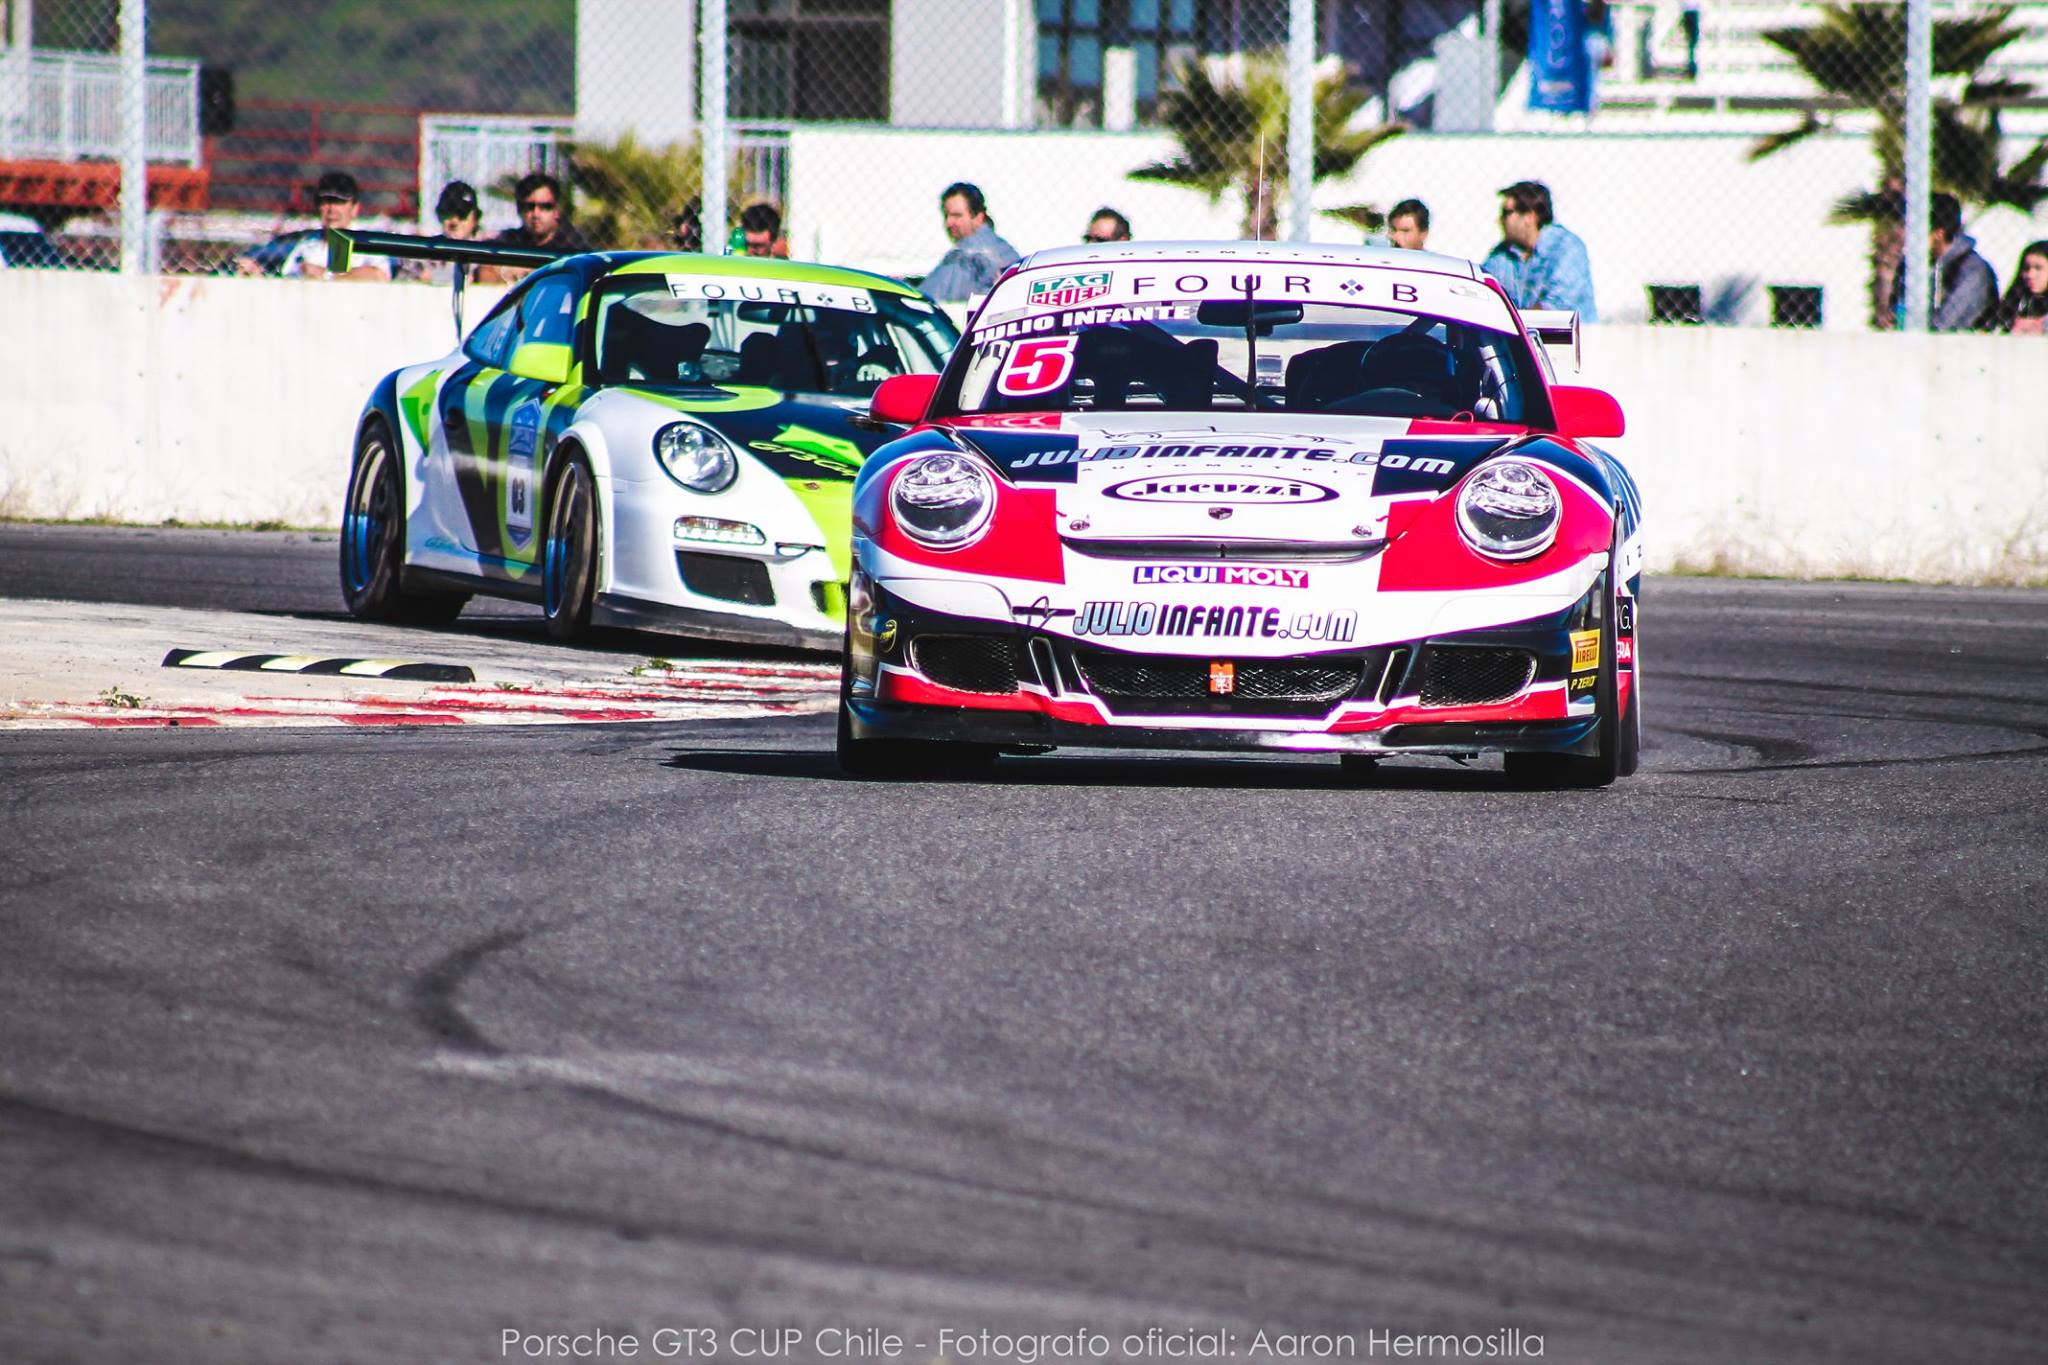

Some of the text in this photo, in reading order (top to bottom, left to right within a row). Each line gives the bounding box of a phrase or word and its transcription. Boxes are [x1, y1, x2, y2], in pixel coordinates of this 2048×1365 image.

[1036, 272, 1105, 293] TAG
[1133, 274, 1419, 303] FOUR B
[670, 283, 873, 313] FOUR B
[1031, 285, 1109, 307] HEUER
[971, 305, 1192, 346] JULIO INFANTE
[1000, 337, 1075, 394] 5
[1131, 482, 1302, 497] Jacuzzi
[1136, 567, 1308, 587] LIQUI MOLY
